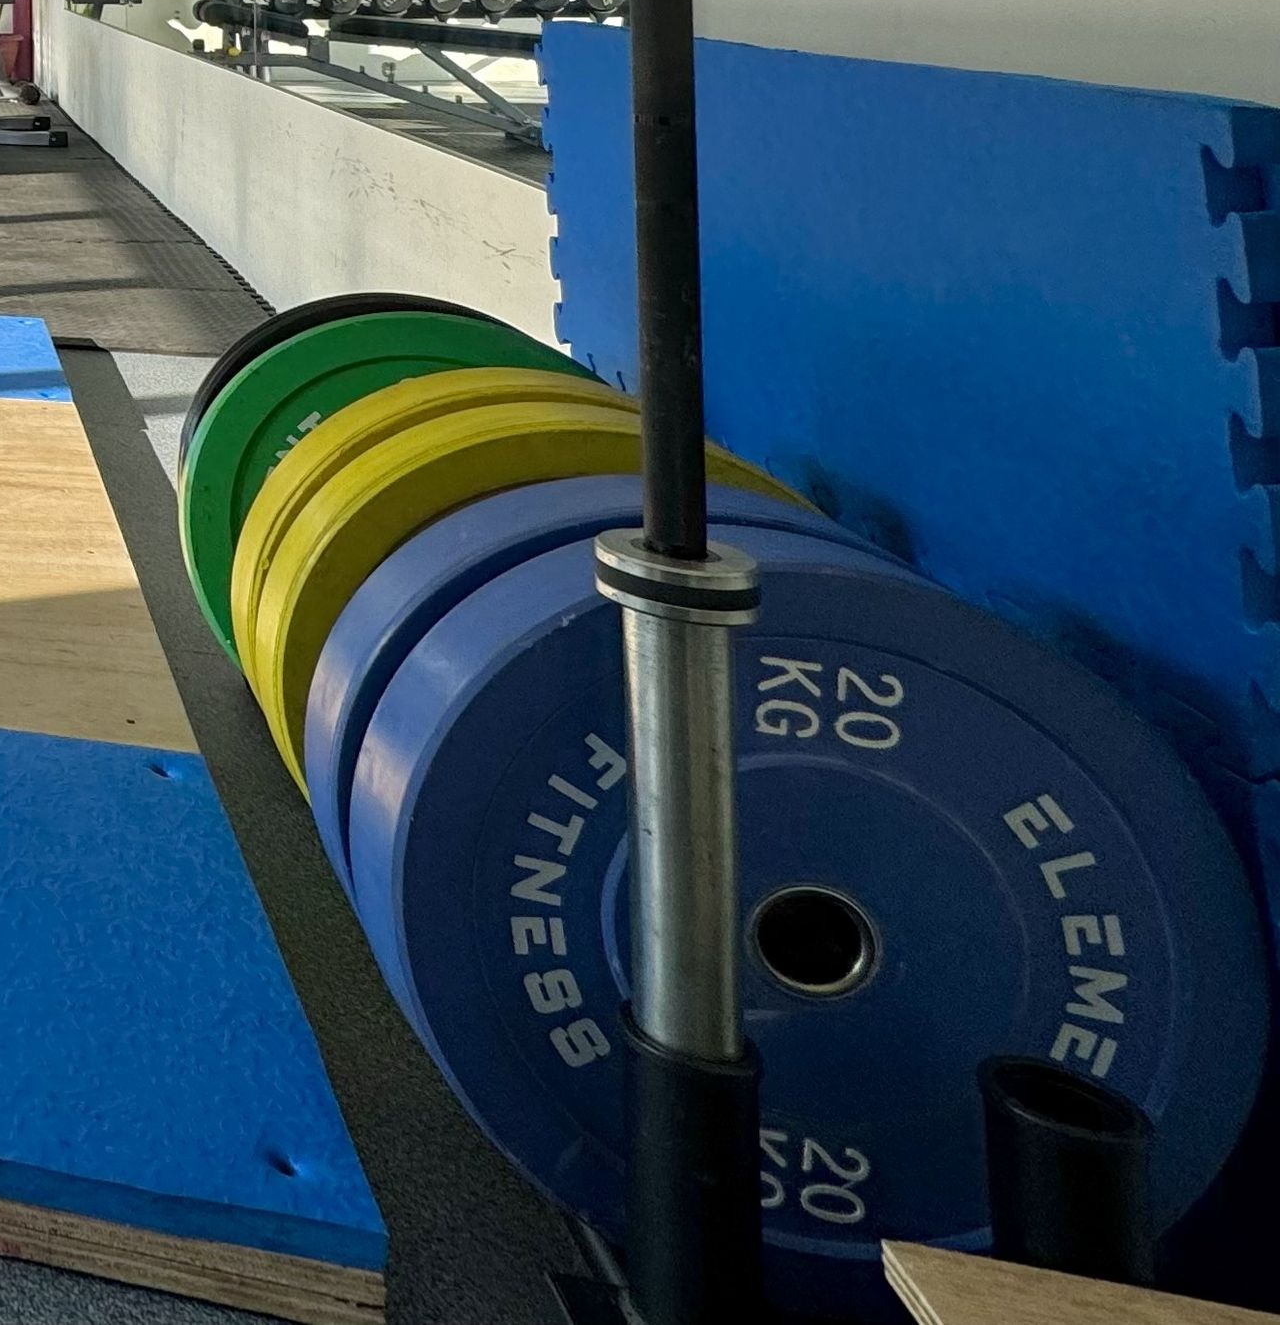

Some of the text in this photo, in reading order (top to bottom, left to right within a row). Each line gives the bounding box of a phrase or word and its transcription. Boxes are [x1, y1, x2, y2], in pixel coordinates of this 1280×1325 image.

[755, 656, 824, 738] KG
[834, 666, 905, 749] 20
[510, 732, 628, 1068] FITNESS
[1003, 793, 1128, 1079] ELEME
[801, 1138, 871, 1224] 20
